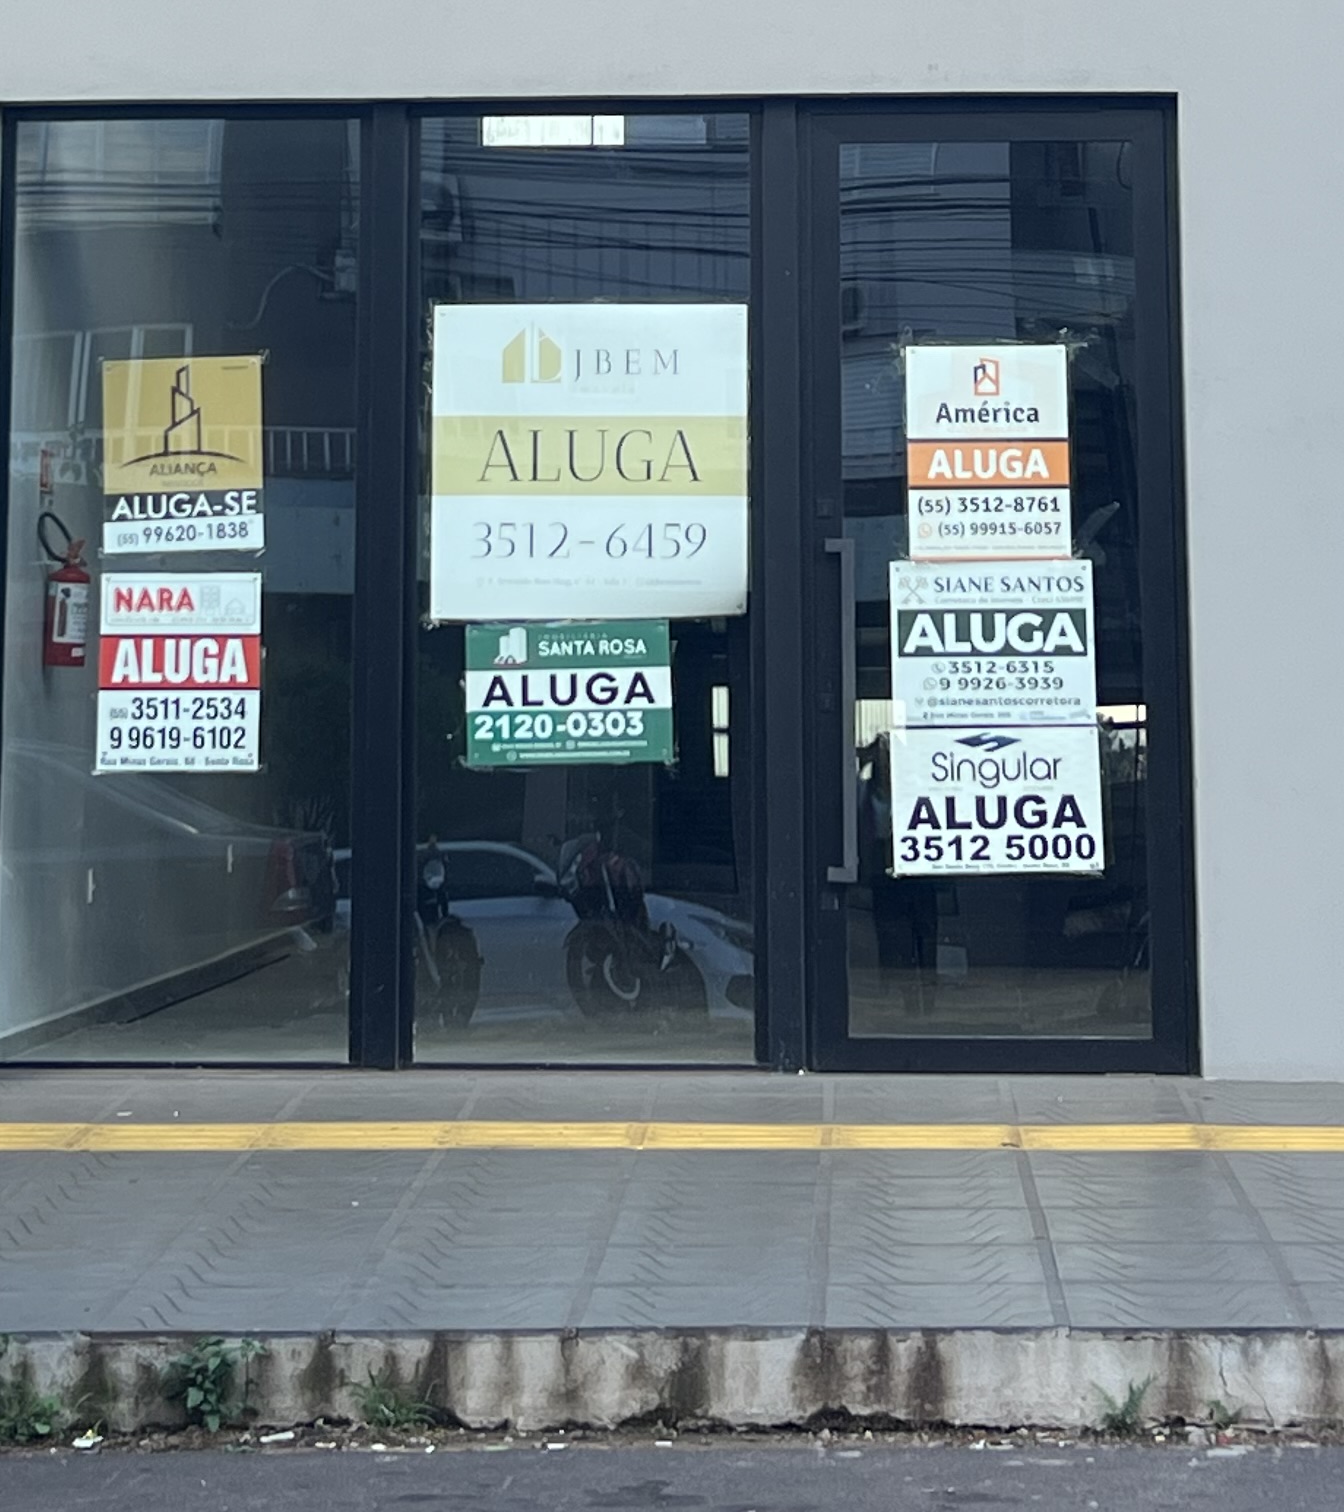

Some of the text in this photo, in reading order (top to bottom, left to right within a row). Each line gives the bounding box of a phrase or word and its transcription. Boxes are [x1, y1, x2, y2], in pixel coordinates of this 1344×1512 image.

[573, 348, 680, 383] JBEM
[936, 400, 1040, 424] América
[477, 428, 702, 483] ALUGA
[927, 448, 1050, 479] ALUGA
[149, 462, 217, 477] ALIANÇA
[111, 491, 257, 520] ALUGA-SE
[918, 496, 1061, 516] (55) 3512-8761
[143, 521, 249, 544] 99620-1838
[470, 521, 707, 560] 3512-6459
[938, 521, 1062, 538] (55) 99915-6057
[934, 576, 1084, 593] SIANE SANTOS
[114, 587, 194, 613] NARA
[904, 612, 1084, 654] ALUGA
[111, 638, 249, 684] ALUGA
[538, 639, 647, 656] SANTA ROSA
[948, 661, 1054, 674] 3512-6315
[481, 671, 655, 707] ALUGA
[940, 677, 1064, 691] 9 9926-3939
[131, 697, 246, 720] 3511-2534
[110, 726, 246, 750] 9 9619-6102
[474, 711, 644, 740] 2120-0303
[932, 751, 1062, 788] Singular
[907, 794, 1087, 830] ALUGA
[900, 833, 1096, 861] 3512 5000
